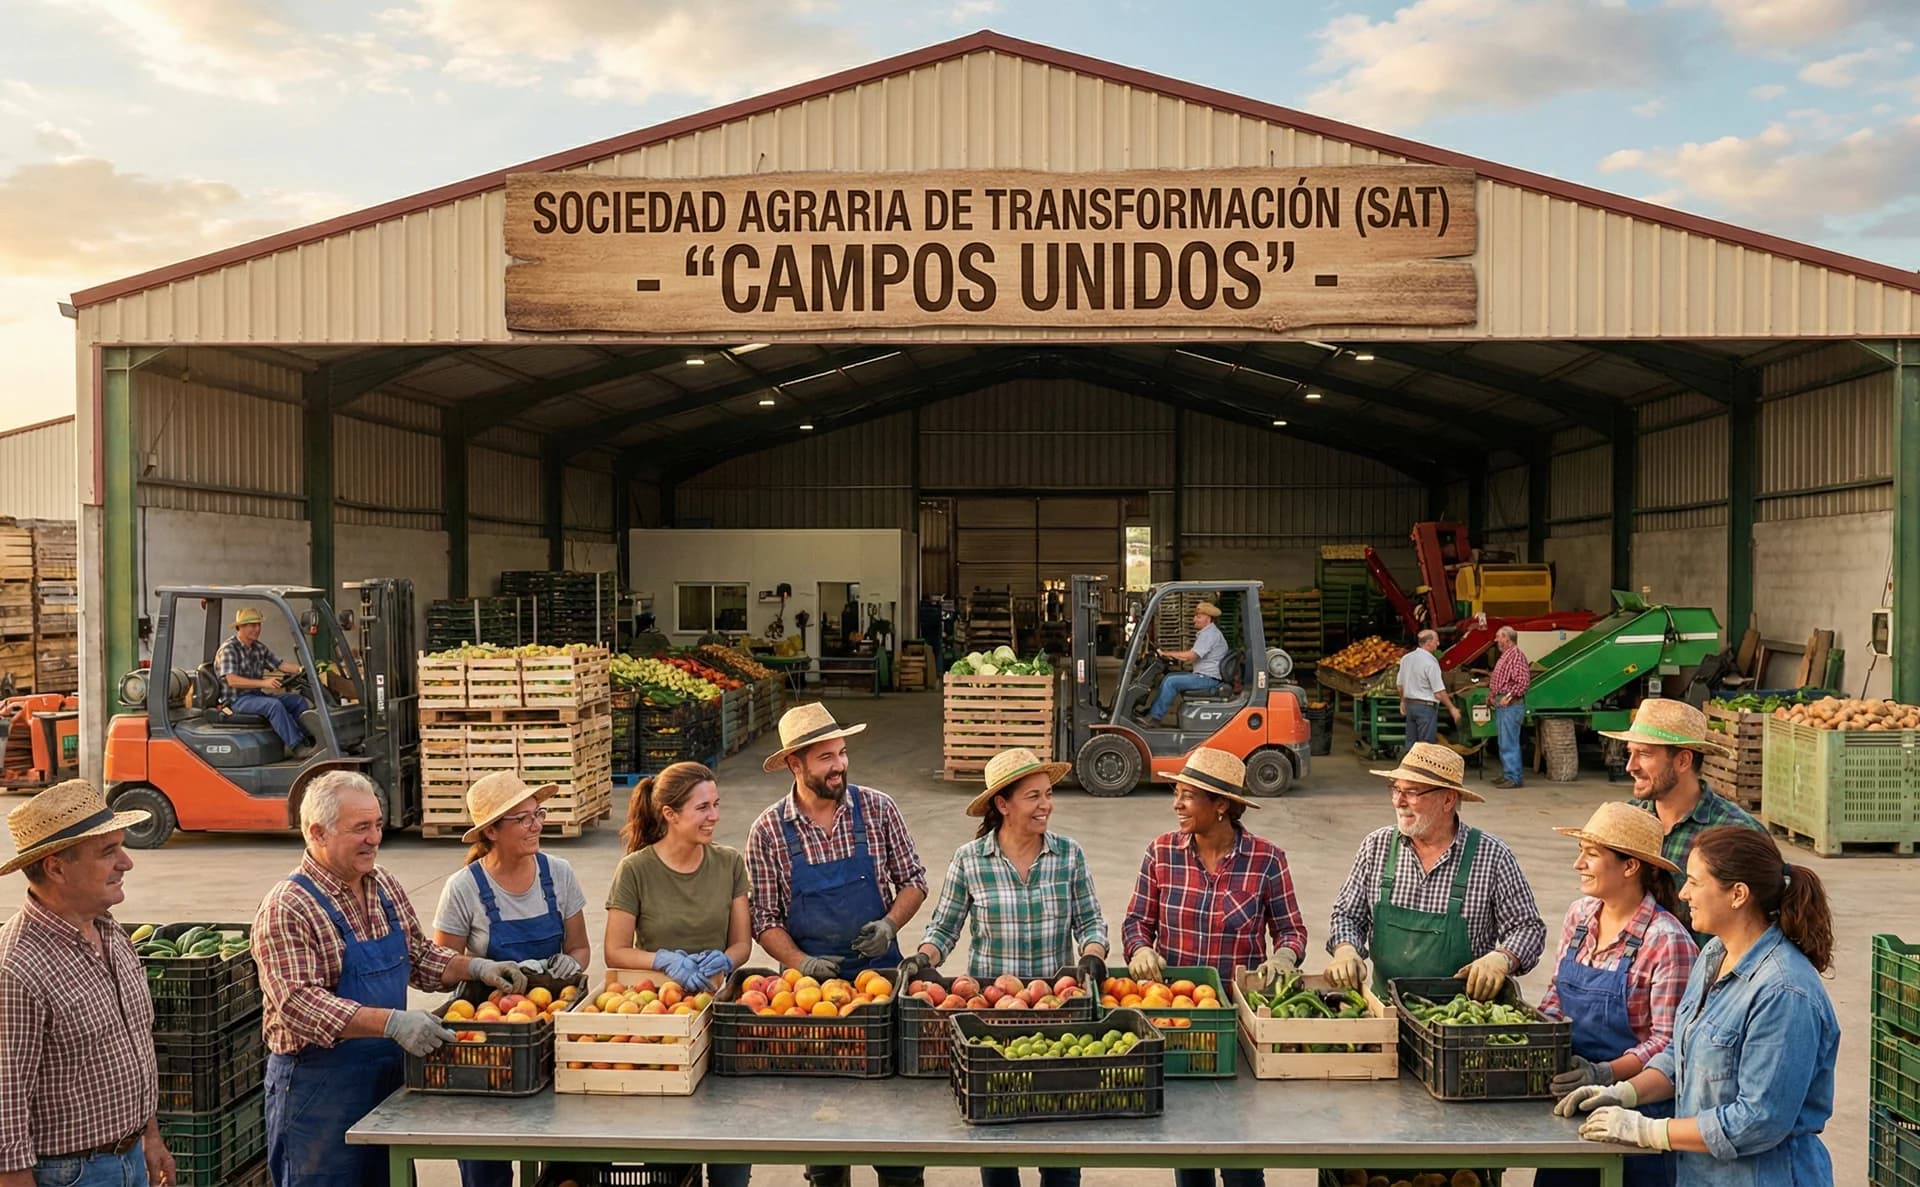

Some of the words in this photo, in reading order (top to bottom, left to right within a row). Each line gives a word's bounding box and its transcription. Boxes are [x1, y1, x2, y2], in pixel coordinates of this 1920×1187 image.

[532, 190, 726, 235] SOCIEDAD
[737, 189, 912, 233] AGRARIA
[924, 189, 973, 231] DE
[984, 176, 1340, 231] TRANSFORMACIÓN
[1354, 185, 1450, 238] (SAT)
[685, 241, 997, 314] “CAMPOS
[1020, 240, 1295, 312] UNIDOS”
